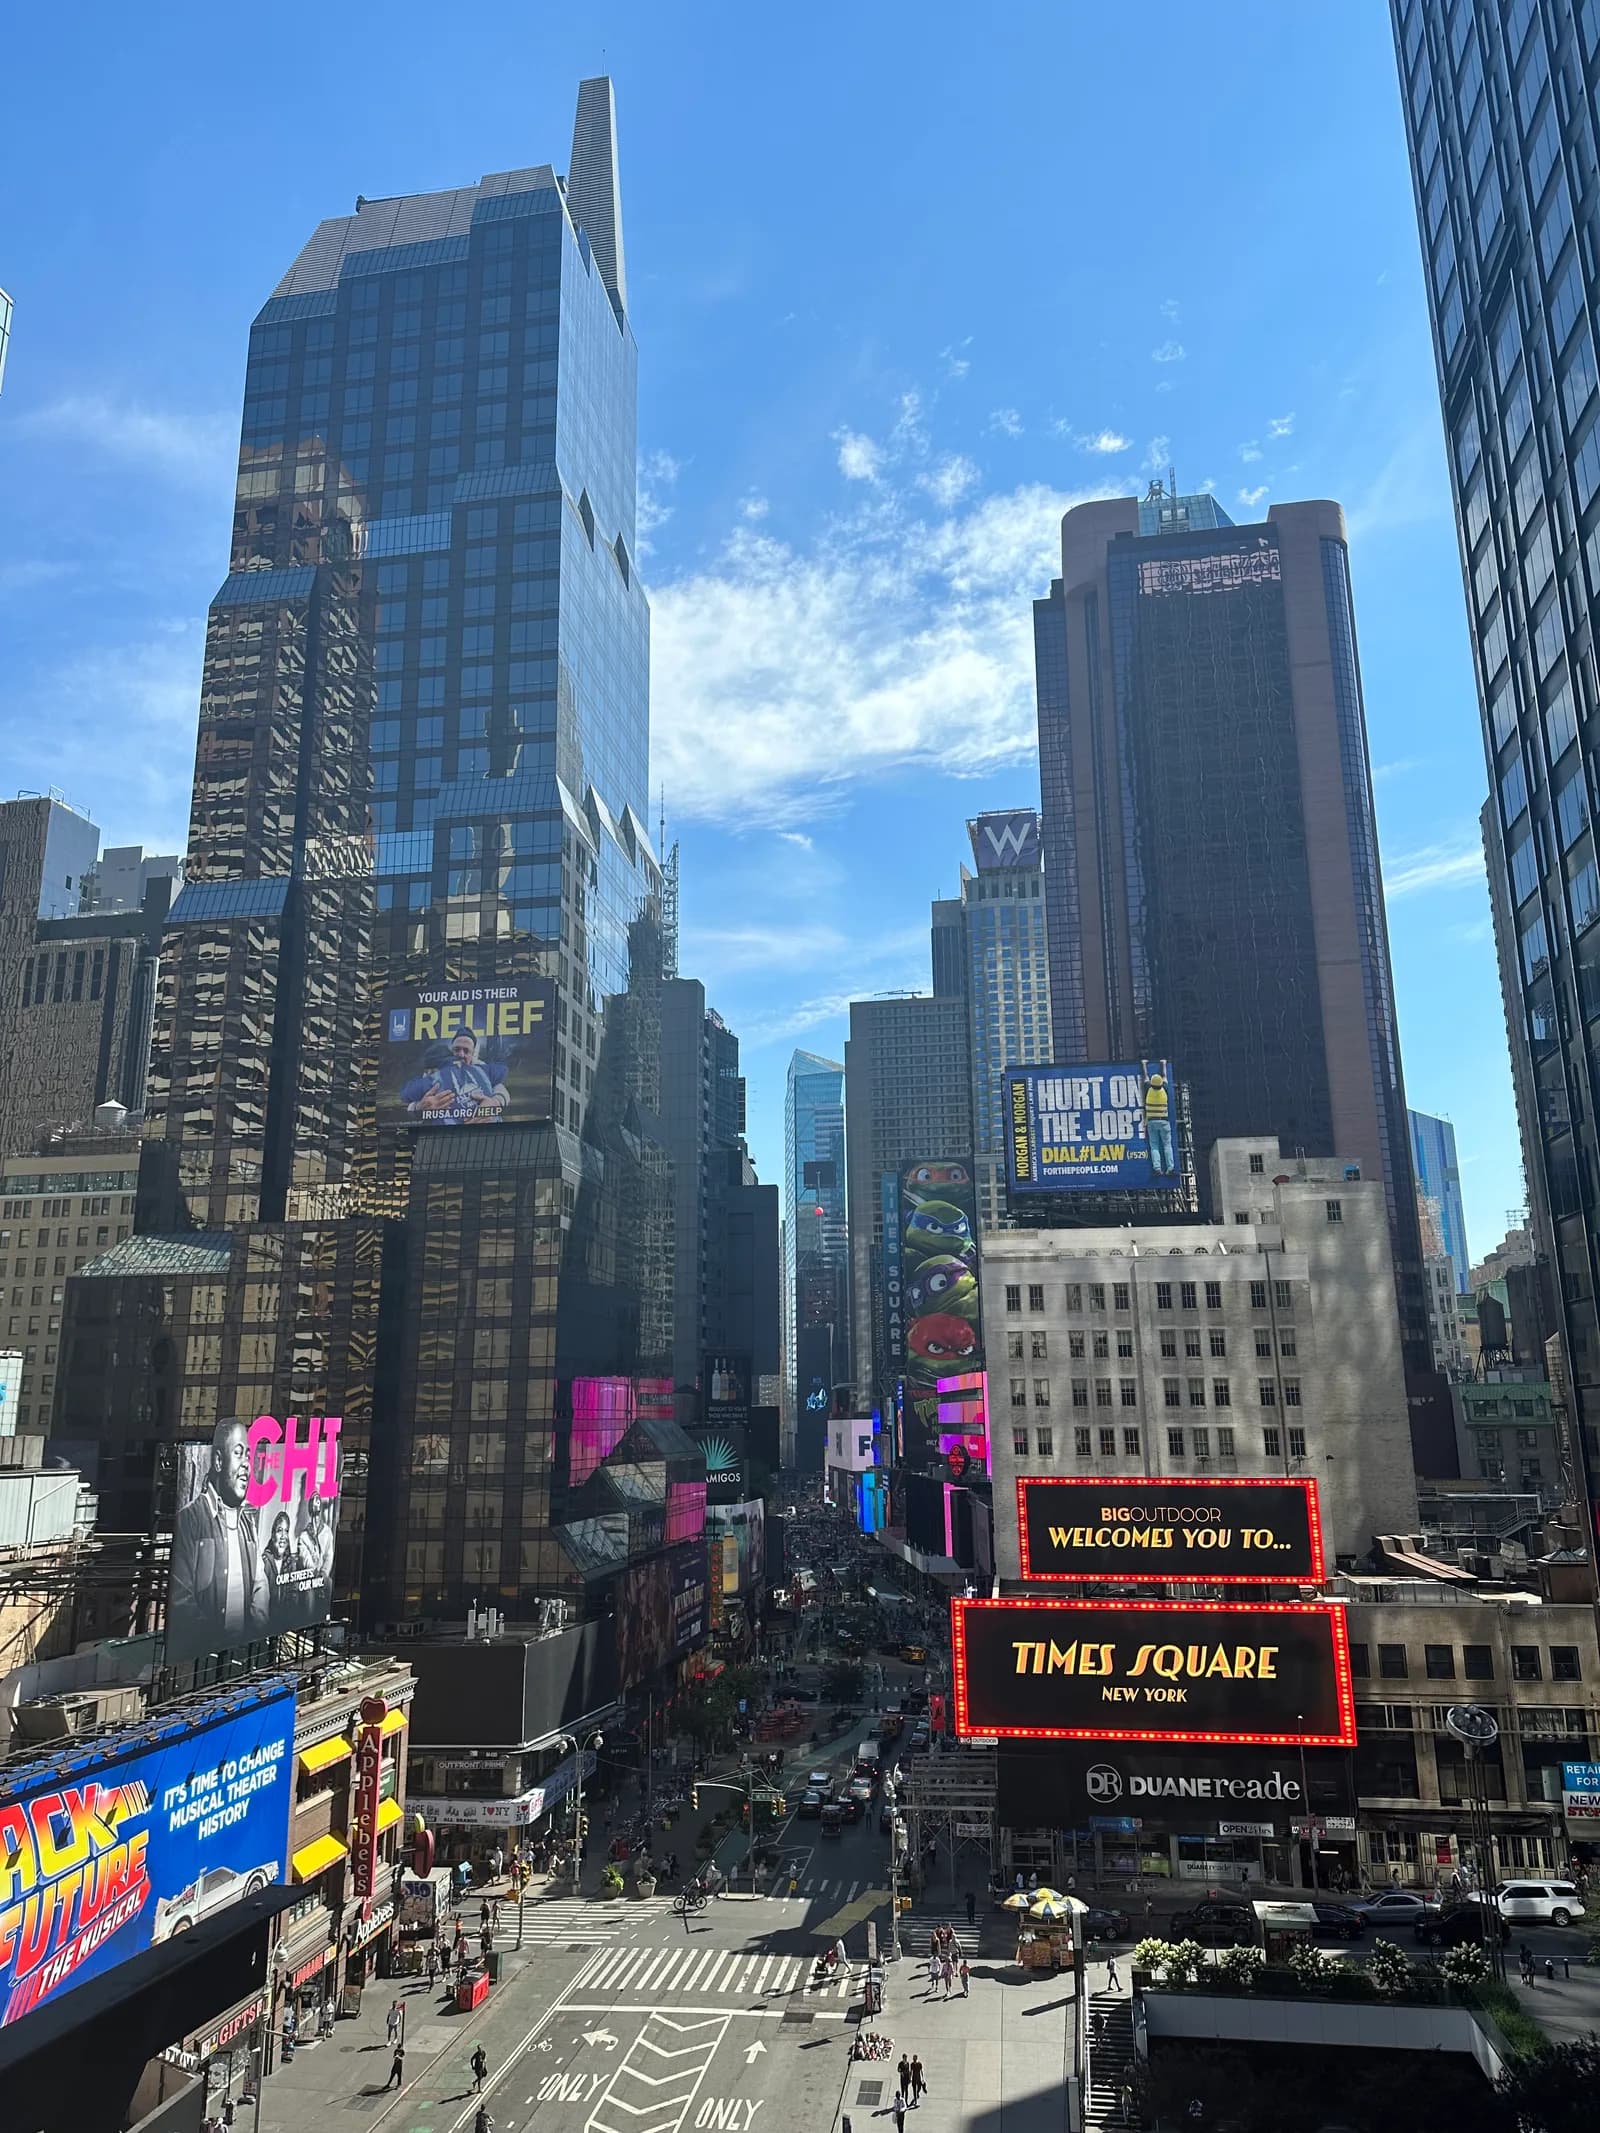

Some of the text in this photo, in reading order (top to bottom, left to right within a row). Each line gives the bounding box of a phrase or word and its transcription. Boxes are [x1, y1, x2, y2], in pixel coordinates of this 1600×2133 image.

[984, 822, 1031, 857] W
[418, 987, 518, 1003] YOUR AID IS THEIR
[414, 1000, 545, 1041] RELIEF
[1037, 1074, 1144, 1112] HURT ON
[422, 1107, 503, 1120] IRUSA.ORG/HELP
[1012, 1083, 1029, 1177] MORGAN & MORGAN
[1038, 1109, 1146, 1143] THE JOB?
[1042, 1144, 1126, 1164] DIAL#LAW
[1043, 1164, 1118, 1176] FORTHEPEOPLE.COM
[1126, 1149, 1148, 1160] (#529)
[886, 1183, 900, 1356] TIMES SQUARE
[246, 1415, 343, 1508] THE CHI
[1048, 1525, 1292, 1549] WELCOMES YOU TO...
[276, 1573, 290, 1585] OUR
[299, 1580, 312, 1591] OUR
[1012, 1639, 1279, 1681] TIMES SQUARE
[1101, 1686, 1188, 1703] NEW YORK
[163, 1739, 285, 1811] IT'S TIME TO CHANGE
[1576, 1777, 1599, 1786] FOR
[169, 1764, 277, 1832] MUSICAL THEATER
[198, 1797, 250, 1840] HISTORY
[1222, 1824, 1248, 1834] OPEN
[39, 1888, 141, 1997] THE MUSICAL
[219, 2003, 256, 2045] GIFTS
[537, 2073, 610, 2101] ONLY
[695, 2097, 764, 2131] ONLY
